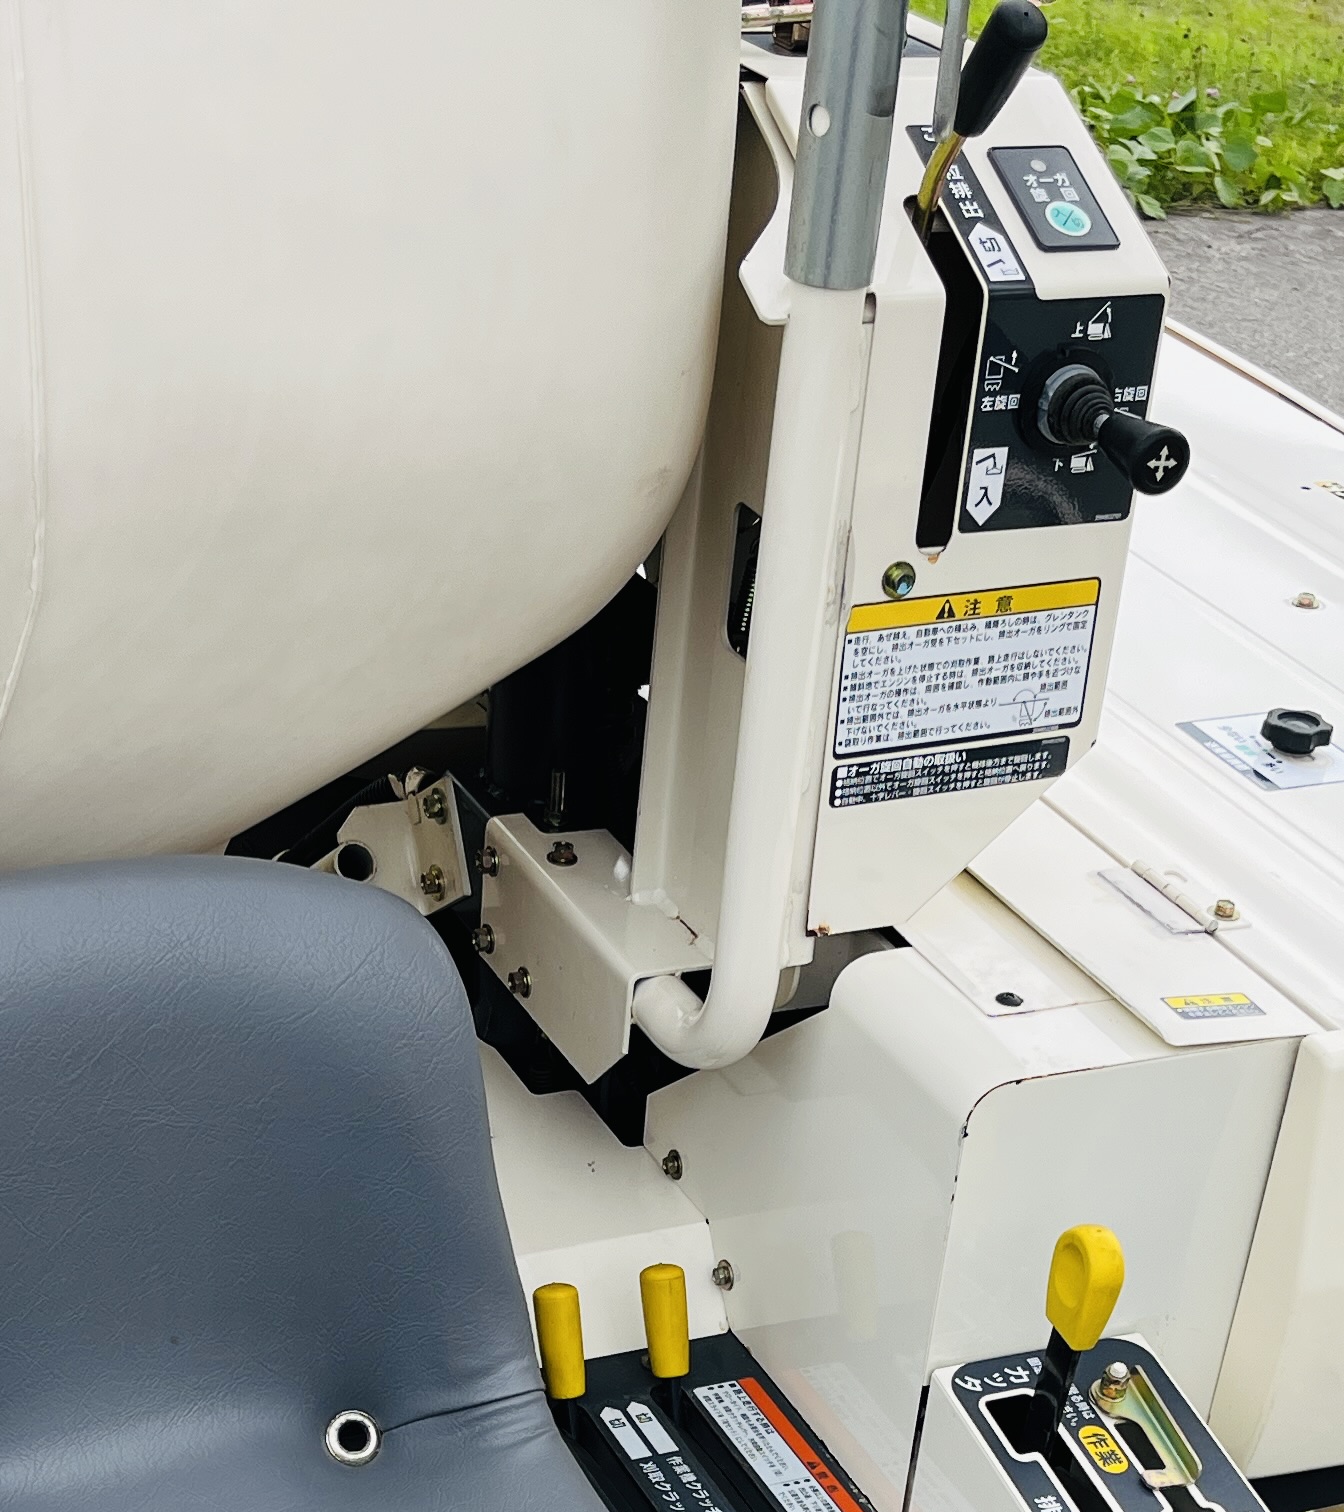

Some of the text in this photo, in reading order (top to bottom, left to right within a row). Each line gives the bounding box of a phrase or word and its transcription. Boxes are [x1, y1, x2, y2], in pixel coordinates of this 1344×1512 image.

[1023, 172, 1071, 188] オーガ
[1070, 322, 1085, 338] 上
[980, 393, 1022, 412] 左旋回
[963, 594, 1013, 617] 注意
[852, 654, 902, 668] してください。
[1081, 1430, 1125, 1469] 作業
